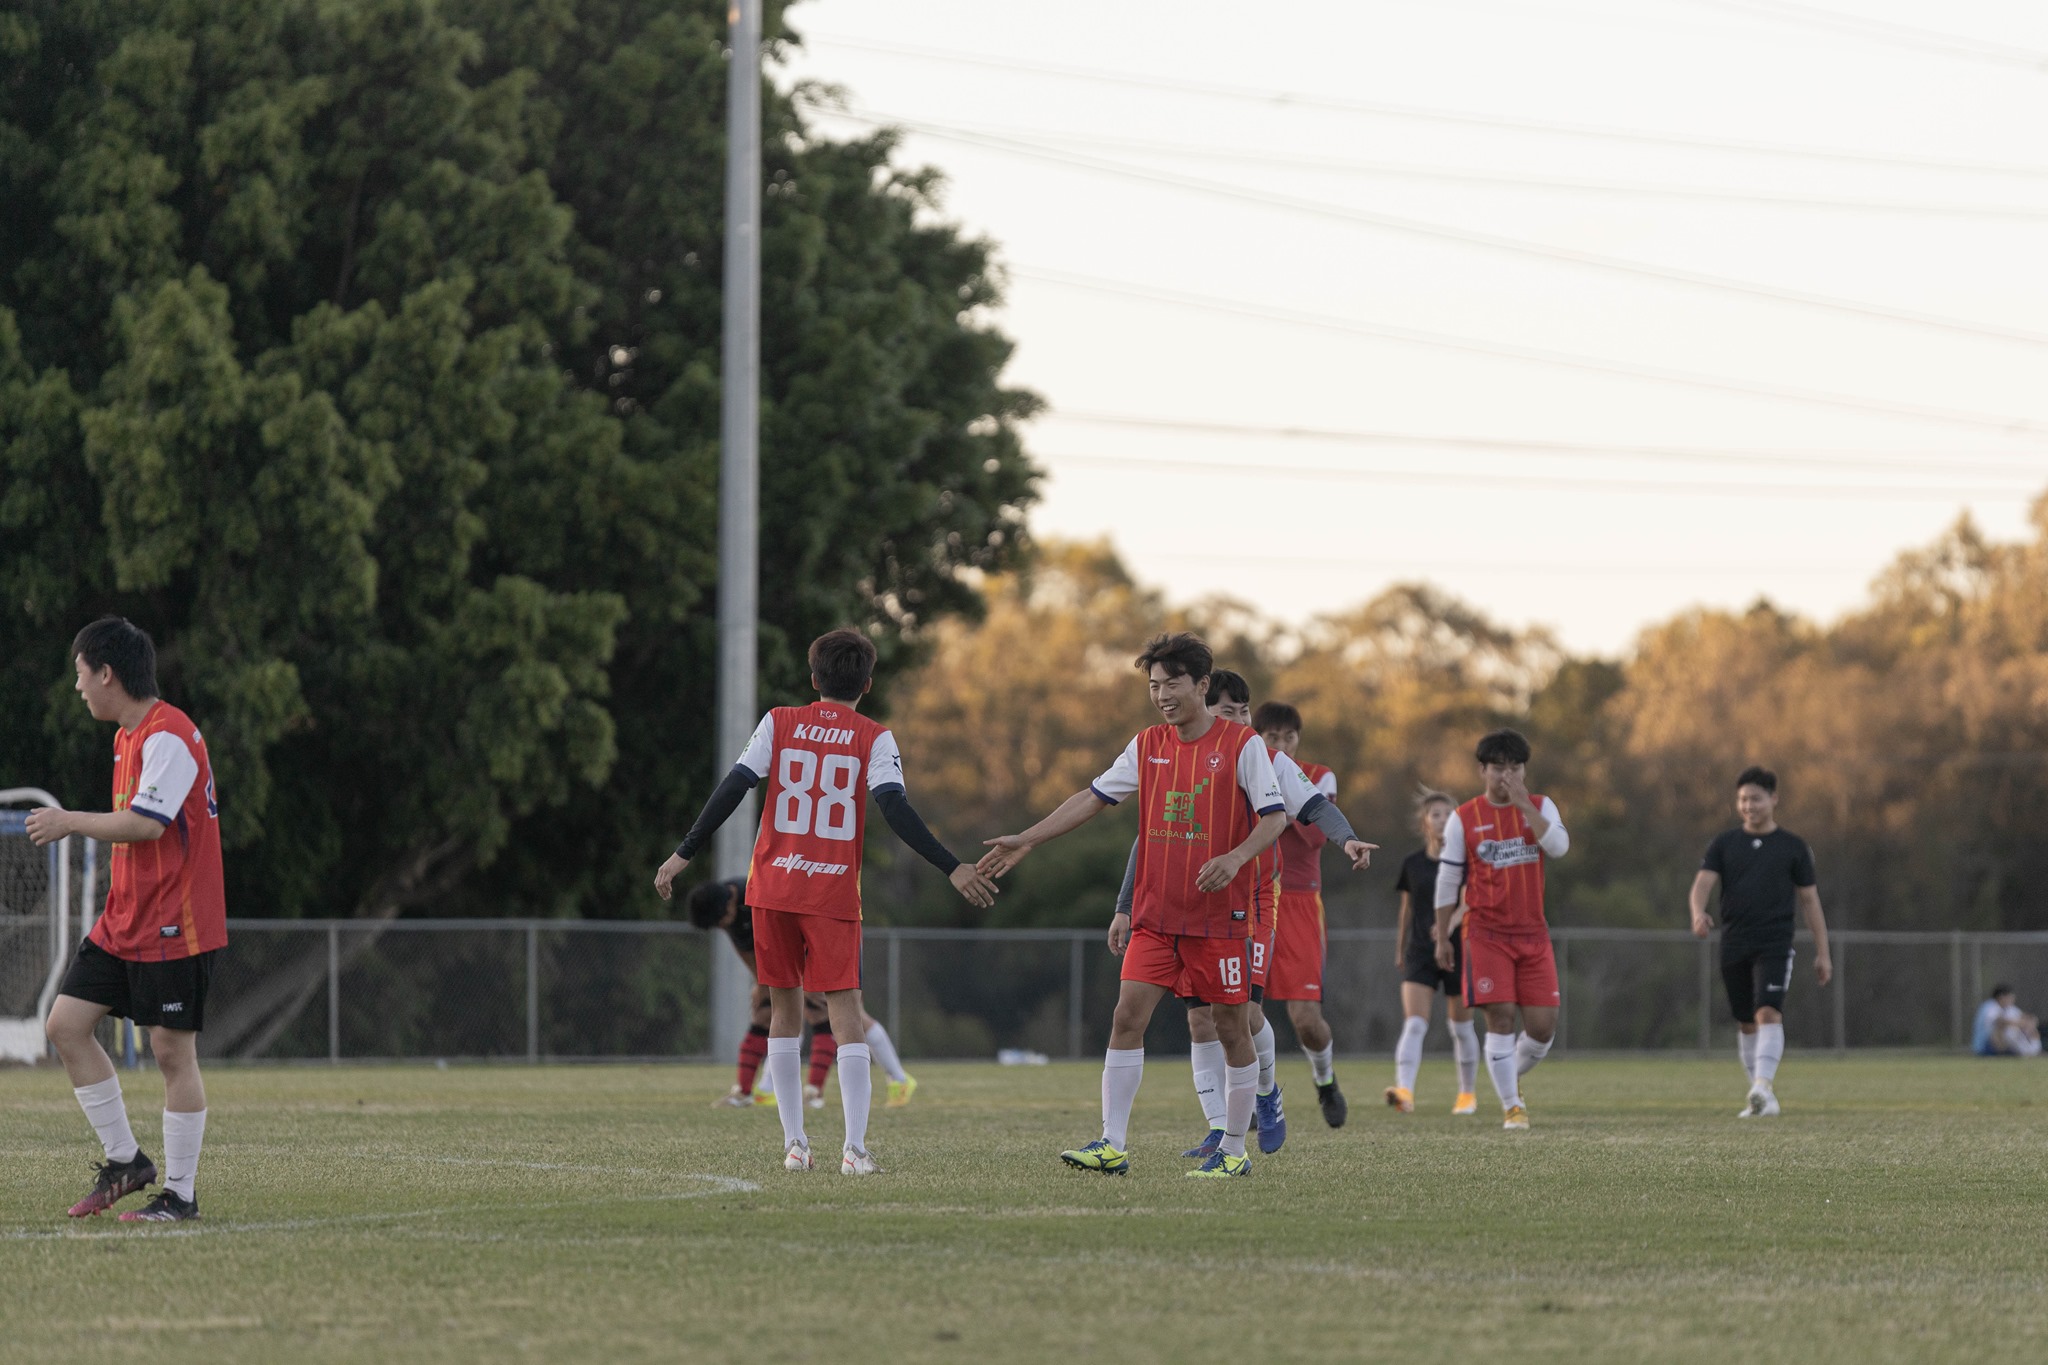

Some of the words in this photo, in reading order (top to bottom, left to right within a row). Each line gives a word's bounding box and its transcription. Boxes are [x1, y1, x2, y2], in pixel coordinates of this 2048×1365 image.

[793, 723, 855, 745] KOON
[774, 748, 861, 841] 88
[1149, 829, 1184, 839] GLOBAL
[1185, 832, 1209, 840] MATE
[1218, 957, 1241, 986] 18
